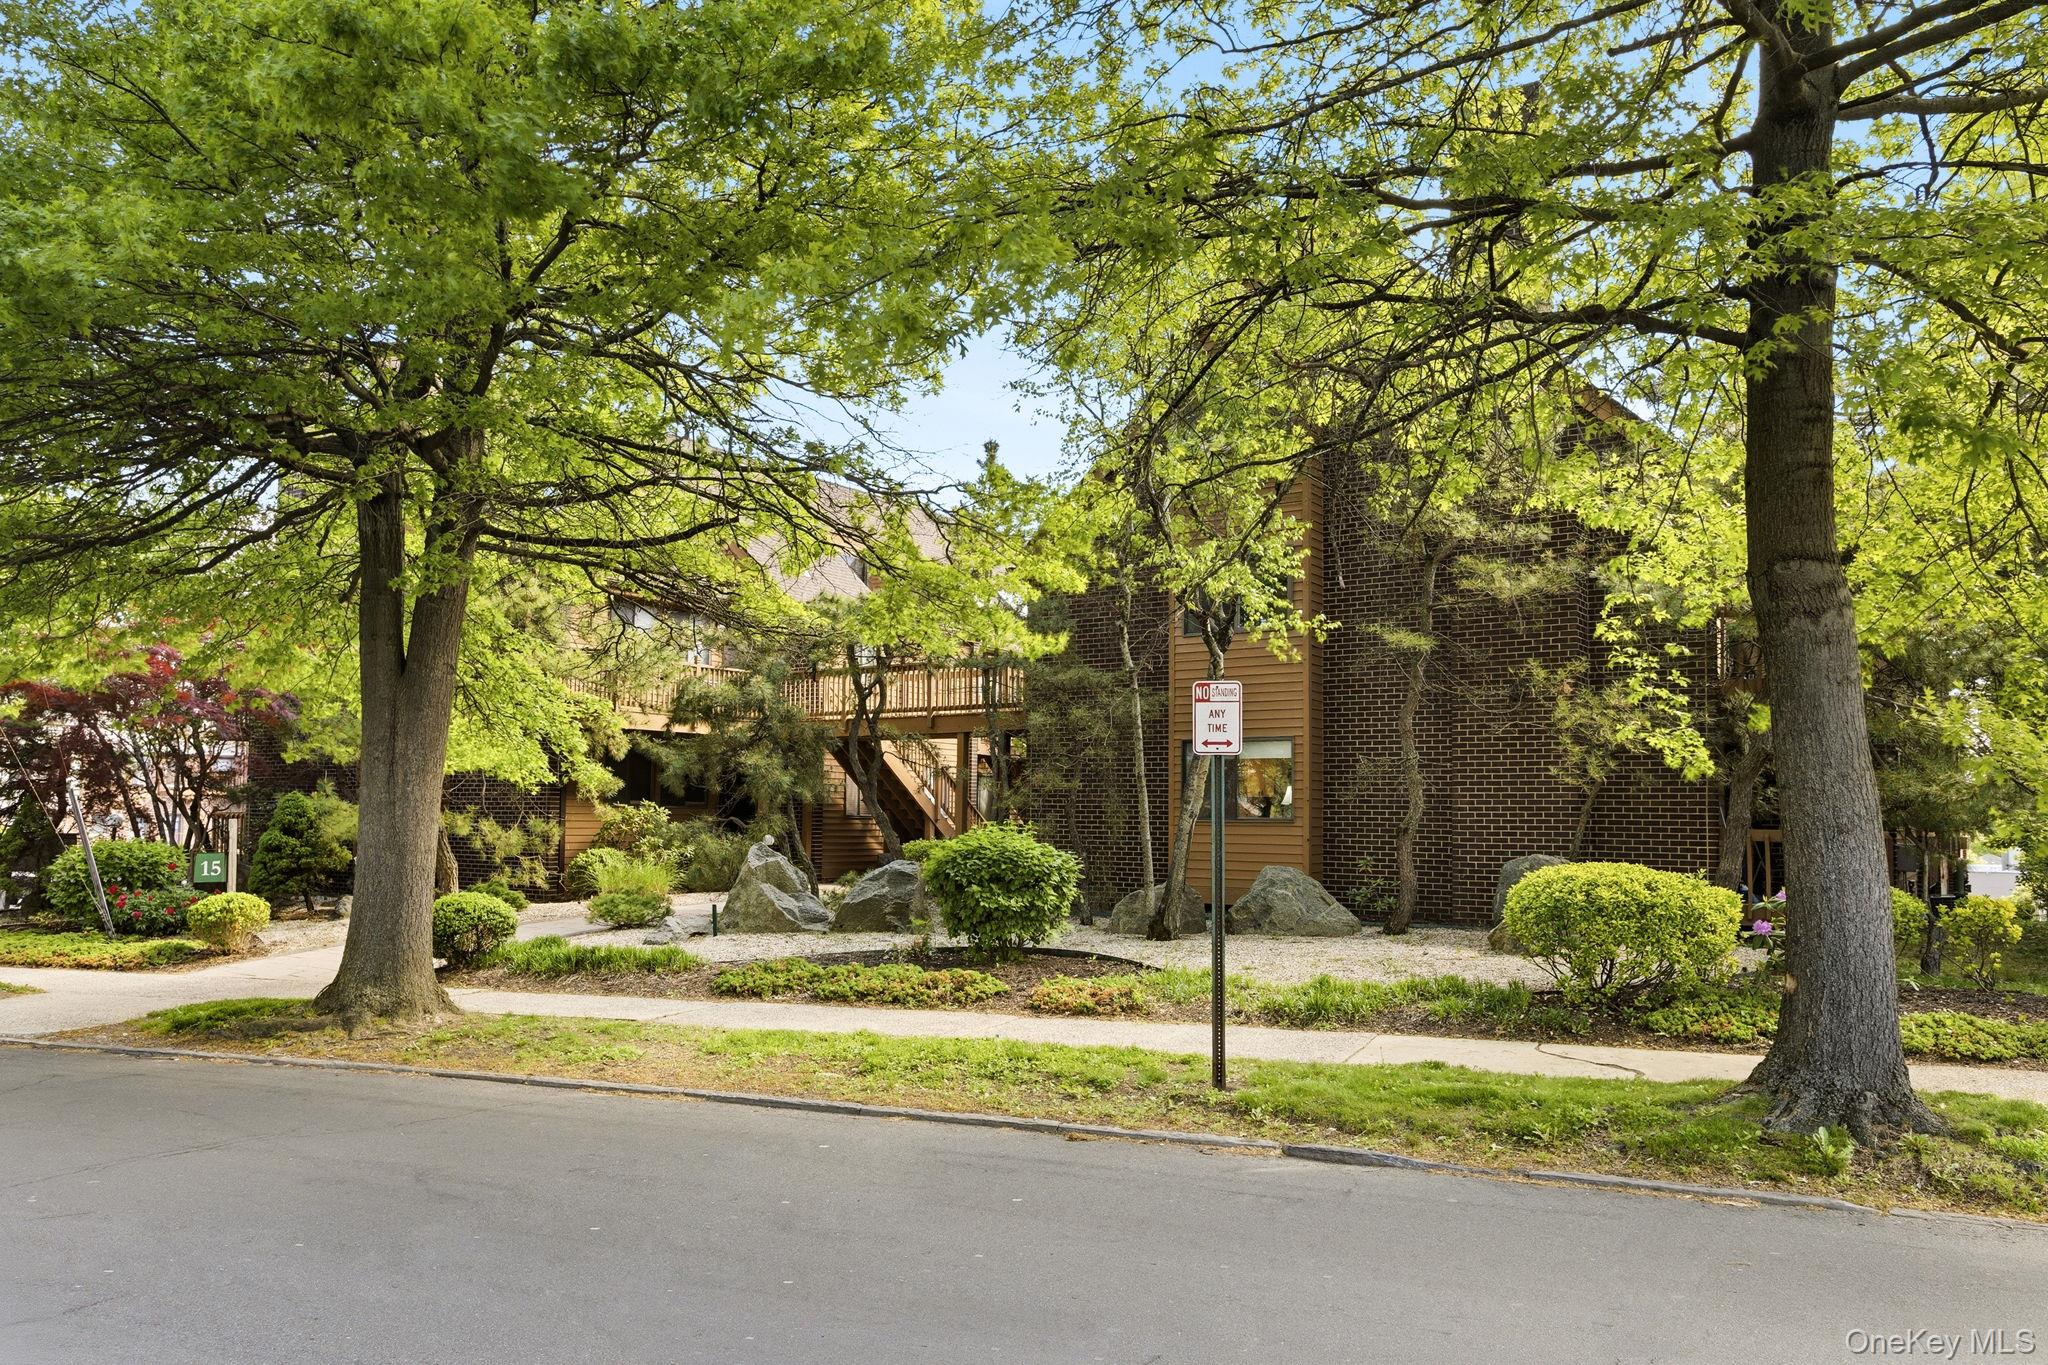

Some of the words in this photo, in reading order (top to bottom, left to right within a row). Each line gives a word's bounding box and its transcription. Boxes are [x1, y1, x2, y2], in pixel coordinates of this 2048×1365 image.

[1195, 686, 1209, 700] NO
[1211, 687, 1238, 698] STANDING
[1208, 709, 1226, 719] ANY
[1207, 723, 1228, 733] TIME
[200, 860, 222, 876] 15
